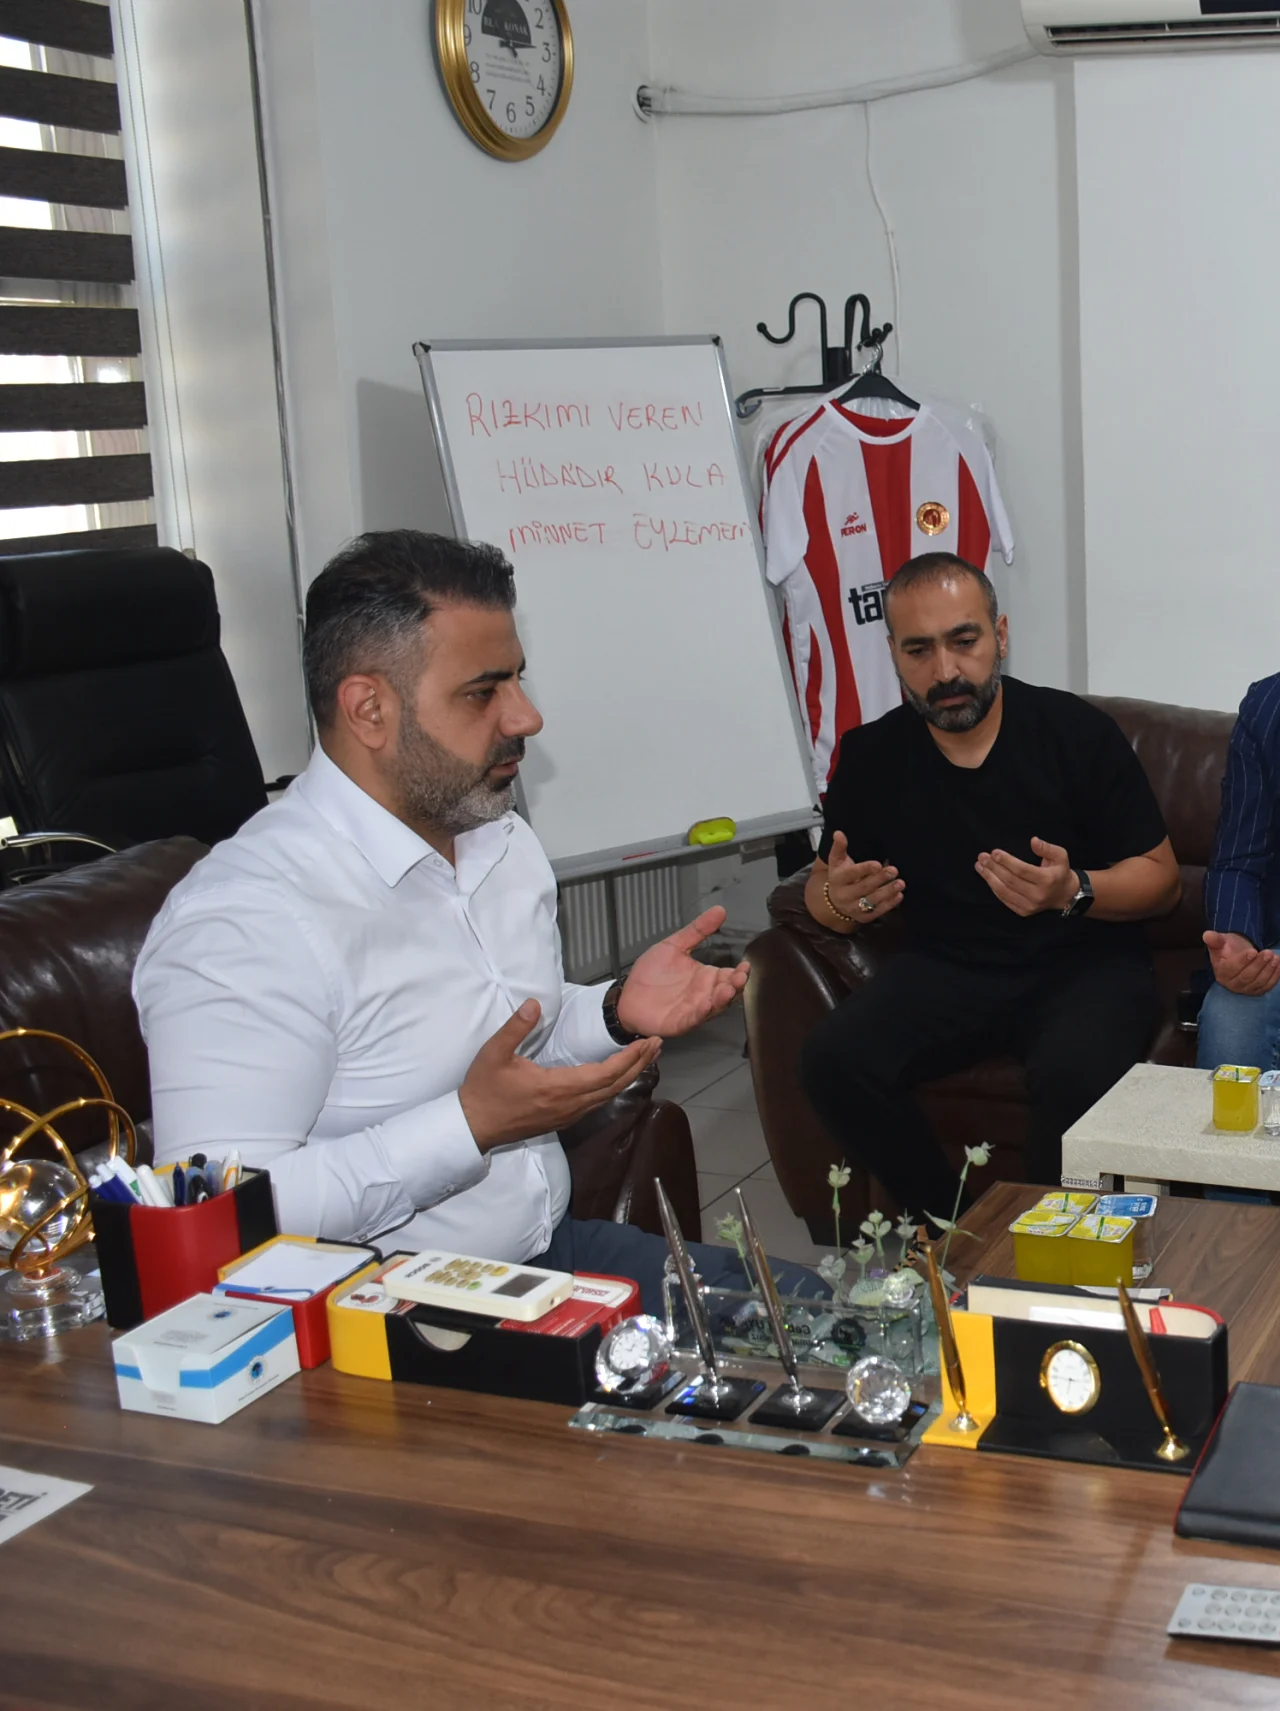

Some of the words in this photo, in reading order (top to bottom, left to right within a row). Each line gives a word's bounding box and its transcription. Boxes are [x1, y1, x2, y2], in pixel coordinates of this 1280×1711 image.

[535, 8, 544, 30] 2
[542, 42, 551, 63] 3
[470, 61, 481, 84] 8
[537, 74, 546, 96] 4
[486, 89, 496, 110] 7
[525, 95, 535, 117] 5
[506, 102, 516, 123] 6
[466, 392, 590, 437] RIZKIMI
[608, 401, 703, 431] VEREN
[643, 462, 728, 492] KULA
[841, 522, 867, 537] PERON
[848, 588, 887, 625] ta
